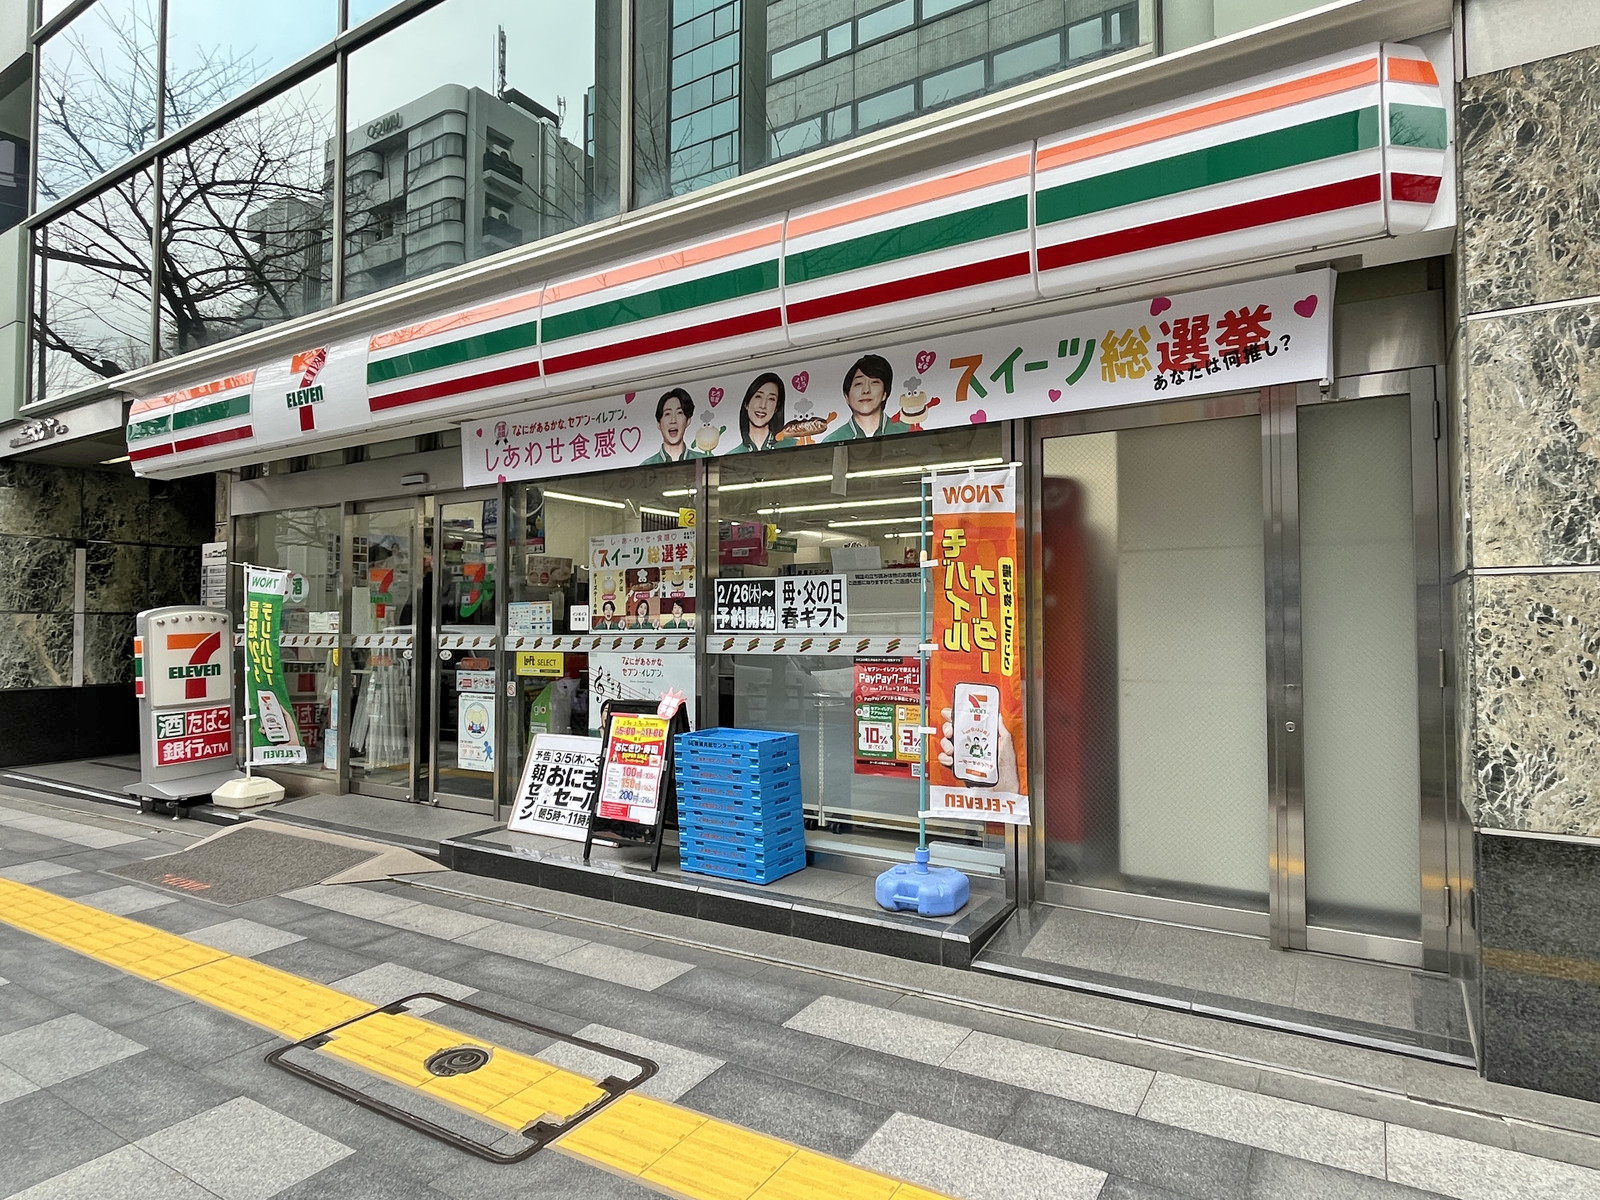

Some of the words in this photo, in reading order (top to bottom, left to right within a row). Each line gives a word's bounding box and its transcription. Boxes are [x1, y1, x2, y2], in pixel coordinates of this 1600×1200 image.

[949, 304, 1273, 402] スイーツ総選挙
[1153, 333, 1292, 391] あなたは何推し?
[286, 385, 323, 408] ELEVEN
[290, 344, 329, 431] 7
[485, 427, 616, 472] しあわせ食感
[598, 543, 688, 566] スイーツ総選挙
[782, 579, 842, 605] 母・父の日
[716, 606, 775, 630] 予約開始
[782, 606, 845, 629] 春ギフト
[167, 632, 220, 699] 7
[169, 664, 221, 679] ELEVEN
[859, 673, 919, 685] PayPayクーポン
[159, 716, 184, 739] 酒
[187, 710, 230, 734] たばこ
[865, 727, 888, 744] 10%
[163, 738, 229, 761] 銀行ATM
[535, 750, 551, 762] 予告
